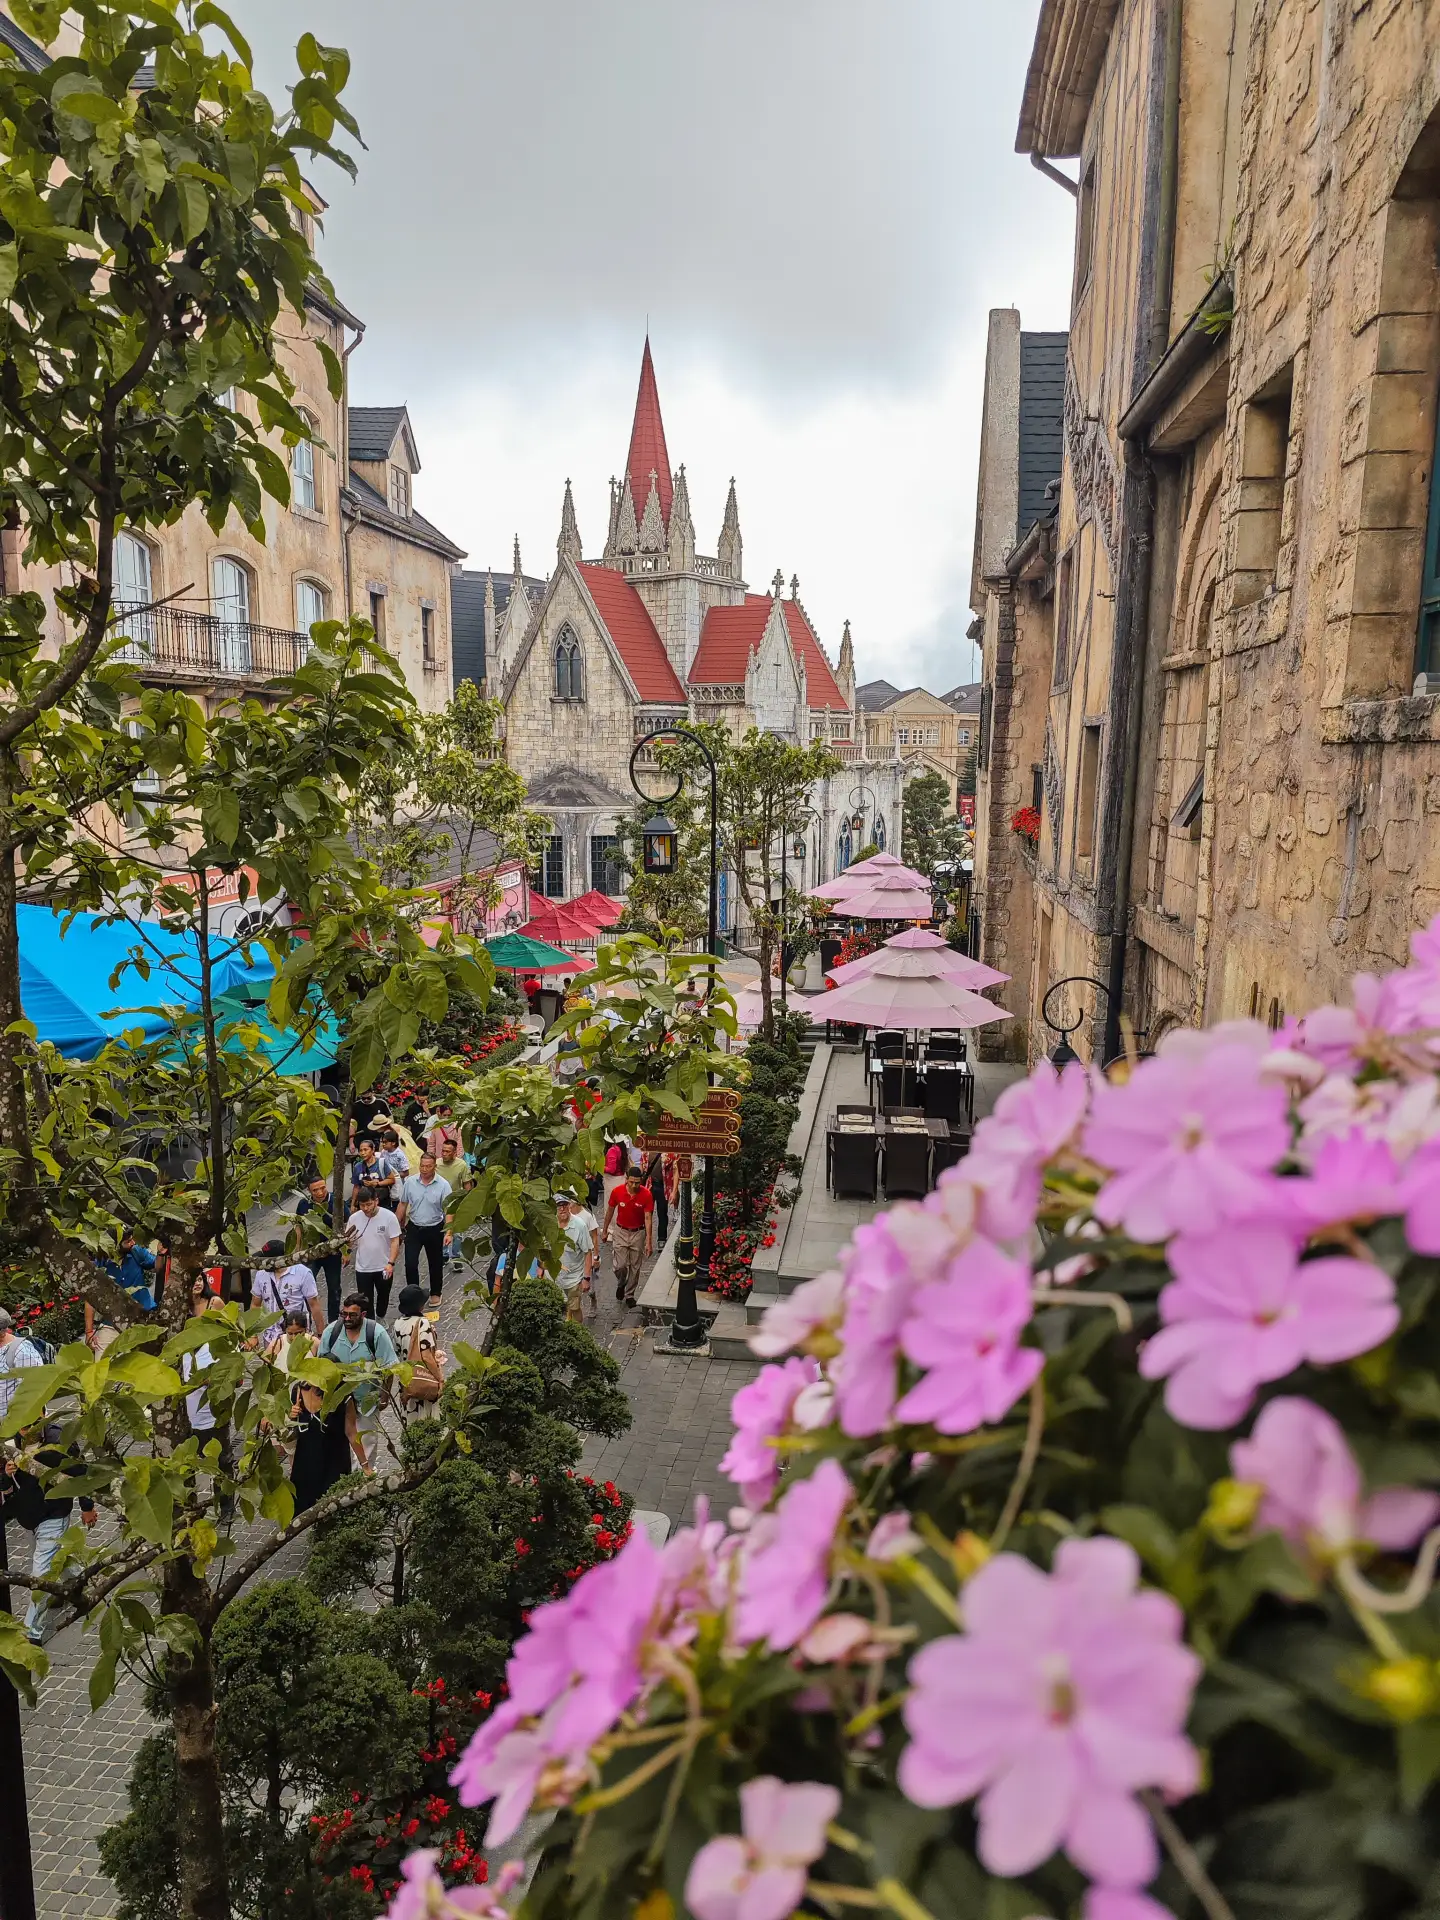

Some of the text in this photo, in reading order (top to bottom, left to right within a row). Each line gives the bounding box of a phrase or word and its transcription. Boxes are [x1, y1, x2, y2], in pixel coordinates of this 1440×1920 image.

[707, 1094, 721, 1102] PARK
[647, 1139, 673, 1148] MERCURE
[673, 1141, 691, 1149] HOTEL
